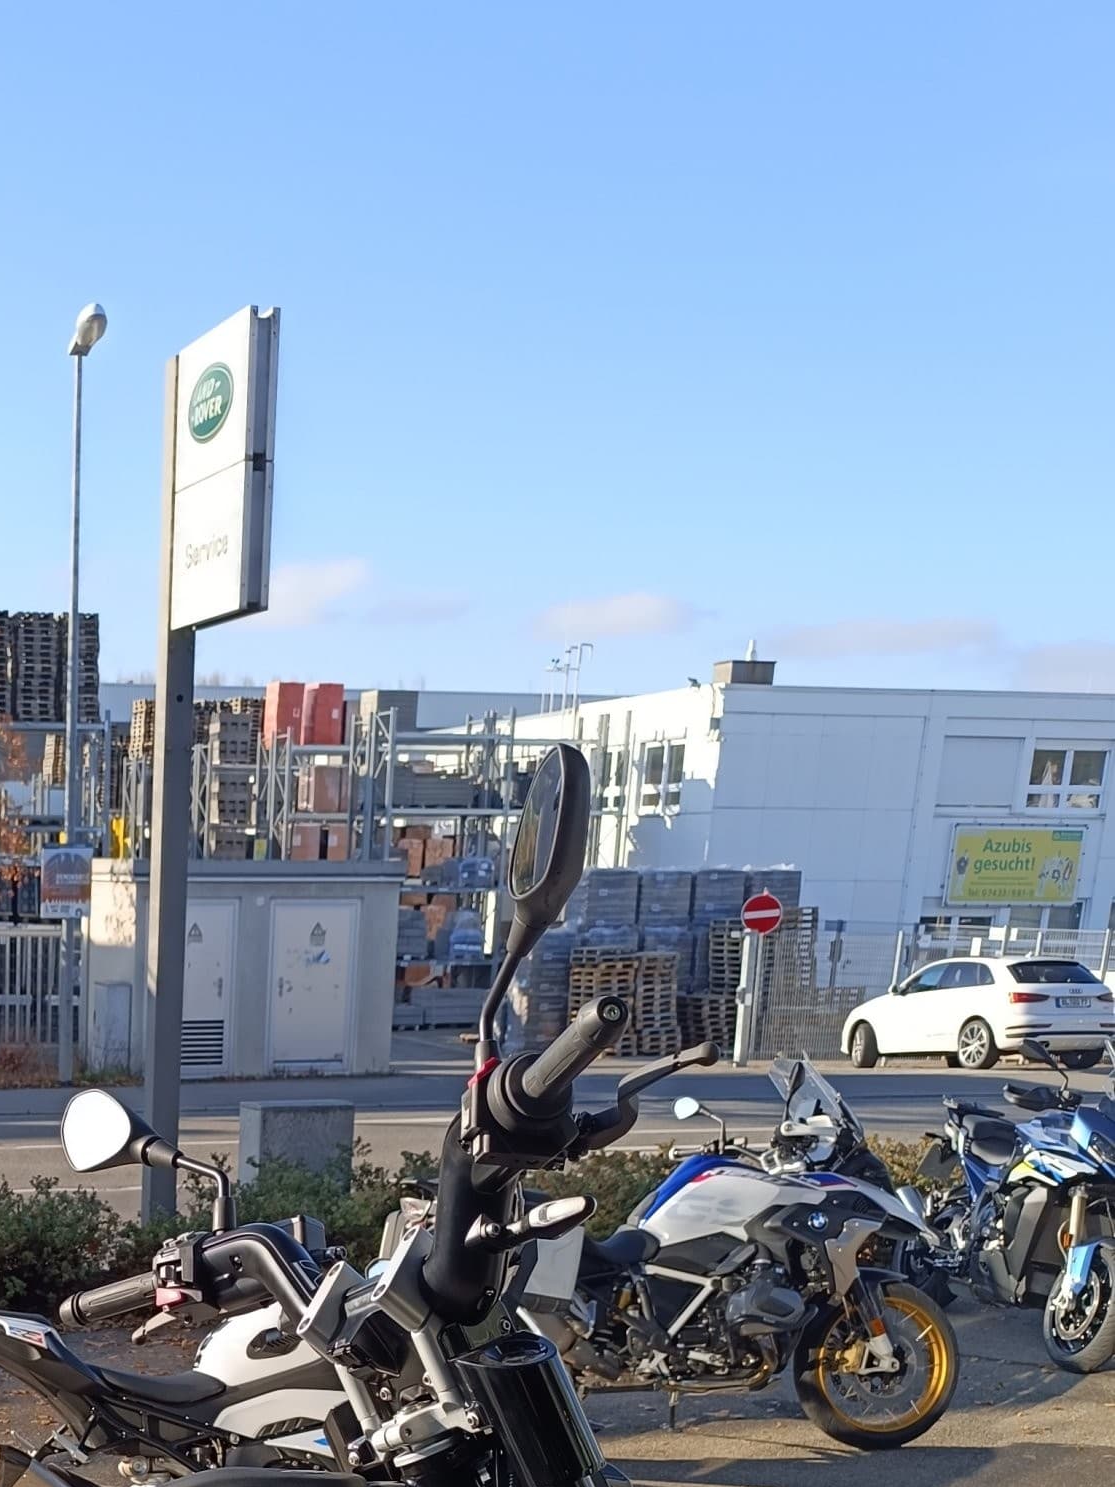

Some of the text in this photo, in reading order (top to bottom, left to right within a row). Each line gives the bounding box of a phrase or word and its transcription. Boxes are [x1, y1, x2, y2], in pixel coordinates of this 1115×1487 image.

[194, 395, 223, 427] ROVER
[185, 533, 228, 569] Service
[983, 839, 1032, 853] Azubis
[973, 856, 1035, 874] gesucht!
